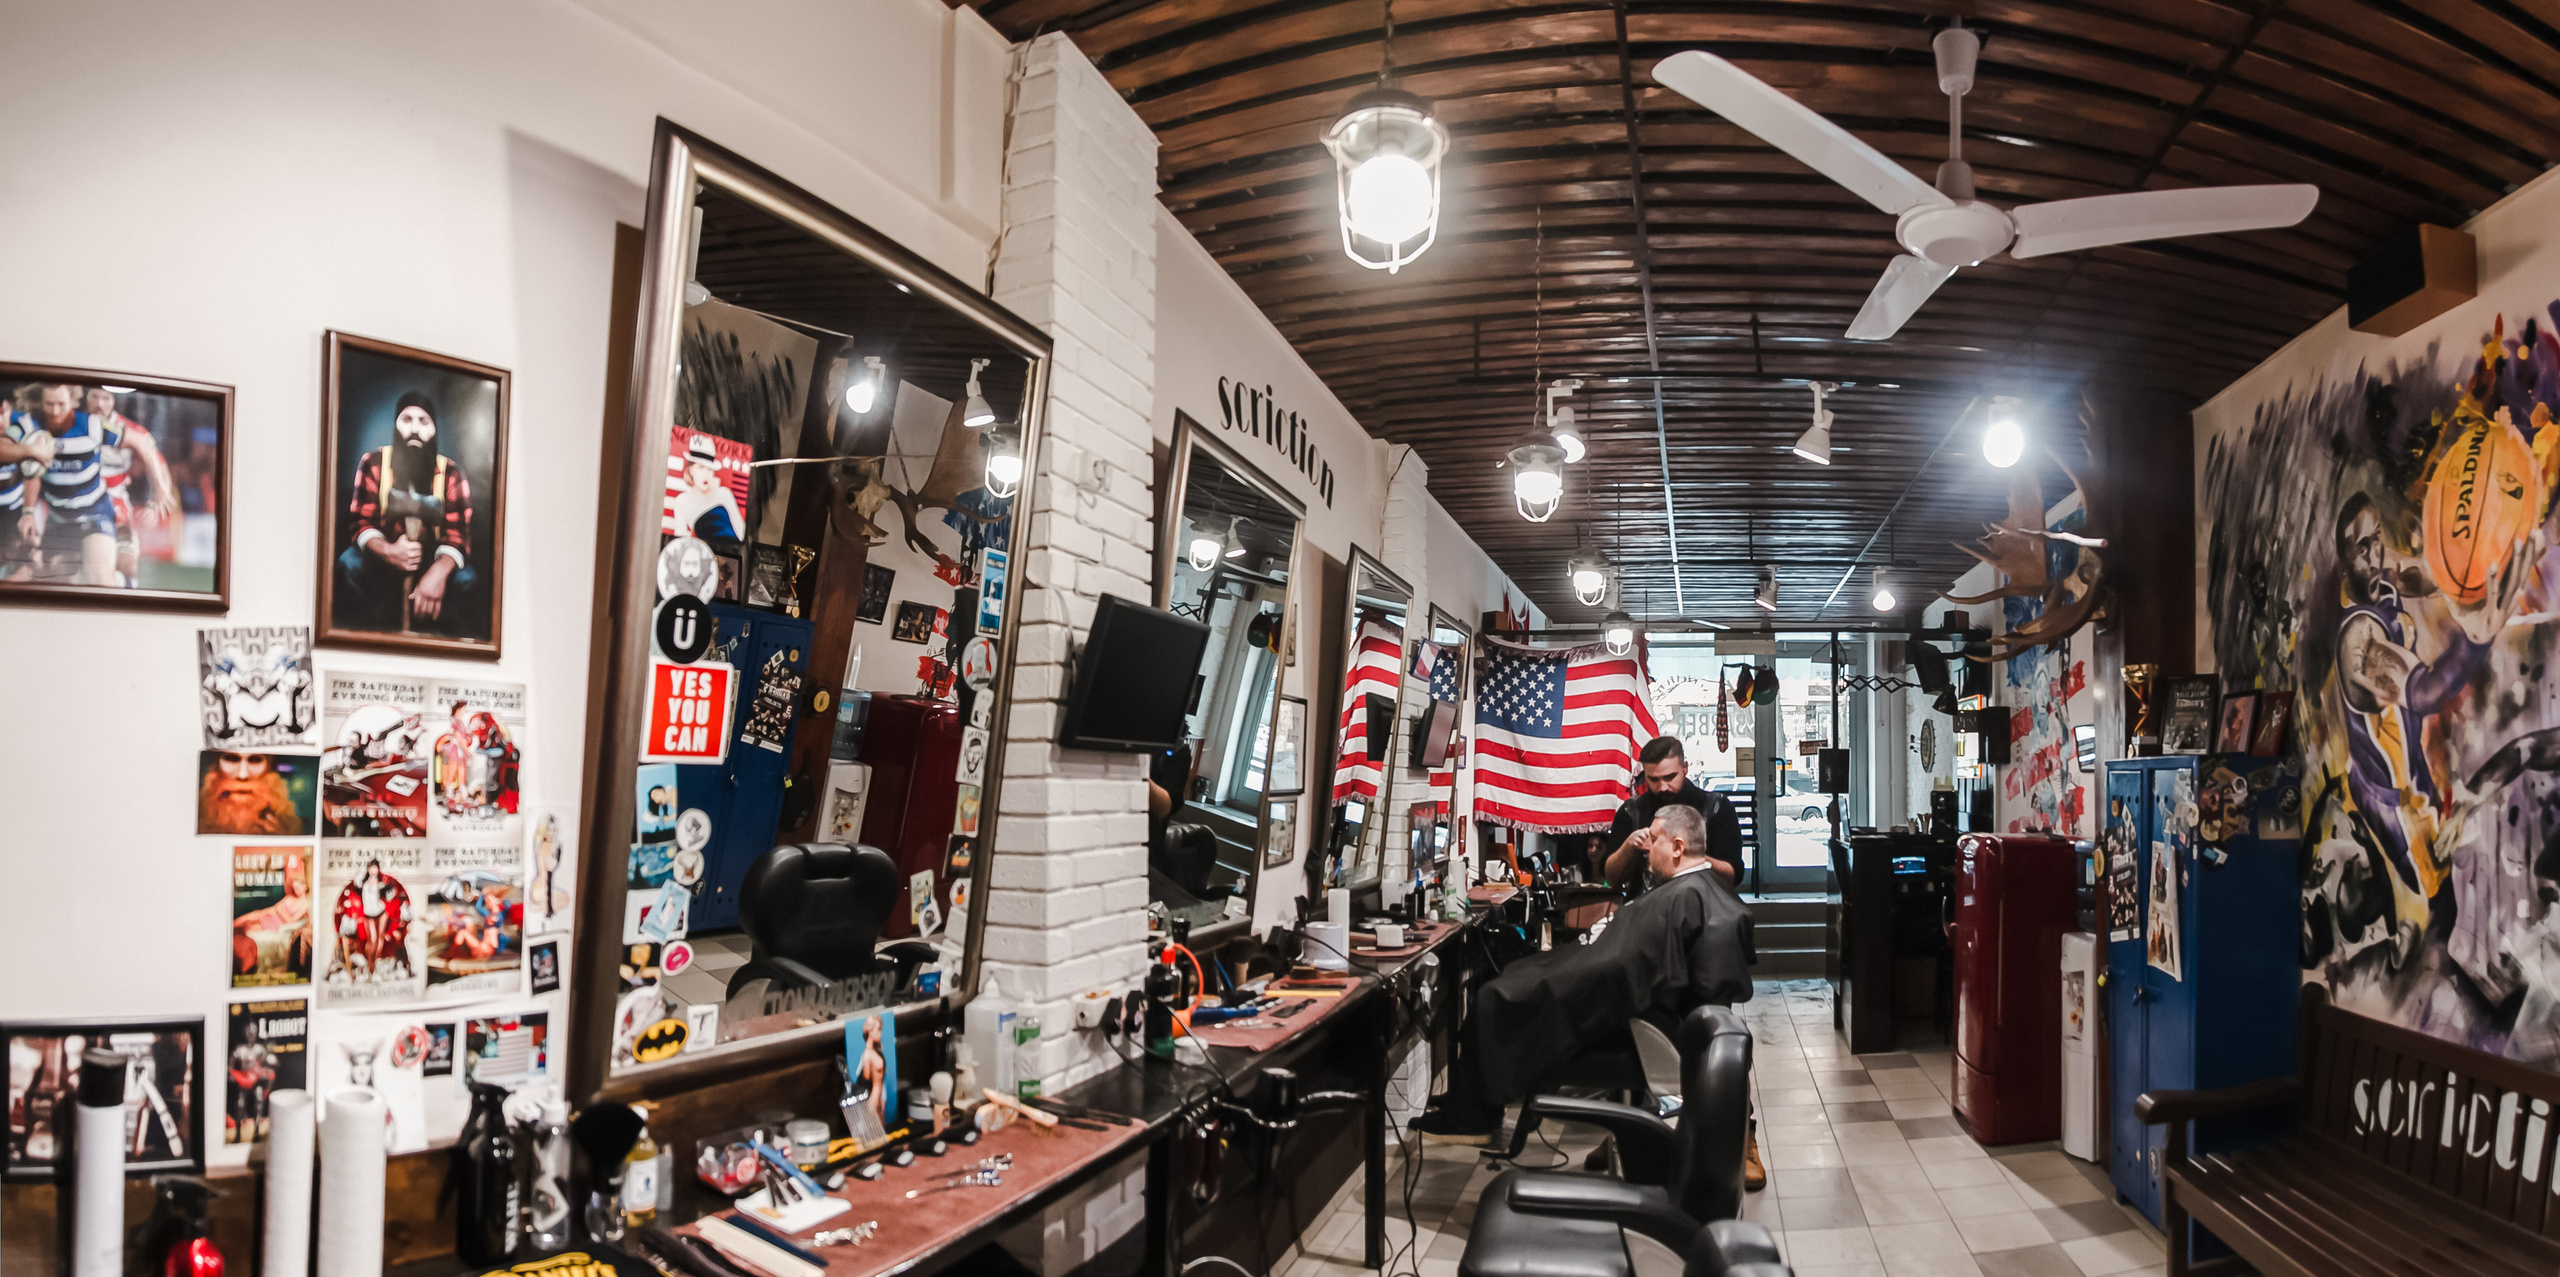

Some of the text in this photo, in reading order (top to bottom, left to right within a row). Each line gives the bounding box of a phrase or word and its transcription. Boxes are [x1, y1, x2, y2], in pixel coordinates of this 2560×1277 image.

[1218, 375, 1334, 510] scriction
[2451, 420, 2490, 539] SPALDING
[673, 607, 697, 650] Ü
[670, 669, 712, 698] YES
[668, 697, 710, 725] YOU
[664, 725, 708, 752] CAN
[235, 872, 285, 887] WOMAN
[2354, 1071, 2560, 1197] scricti
